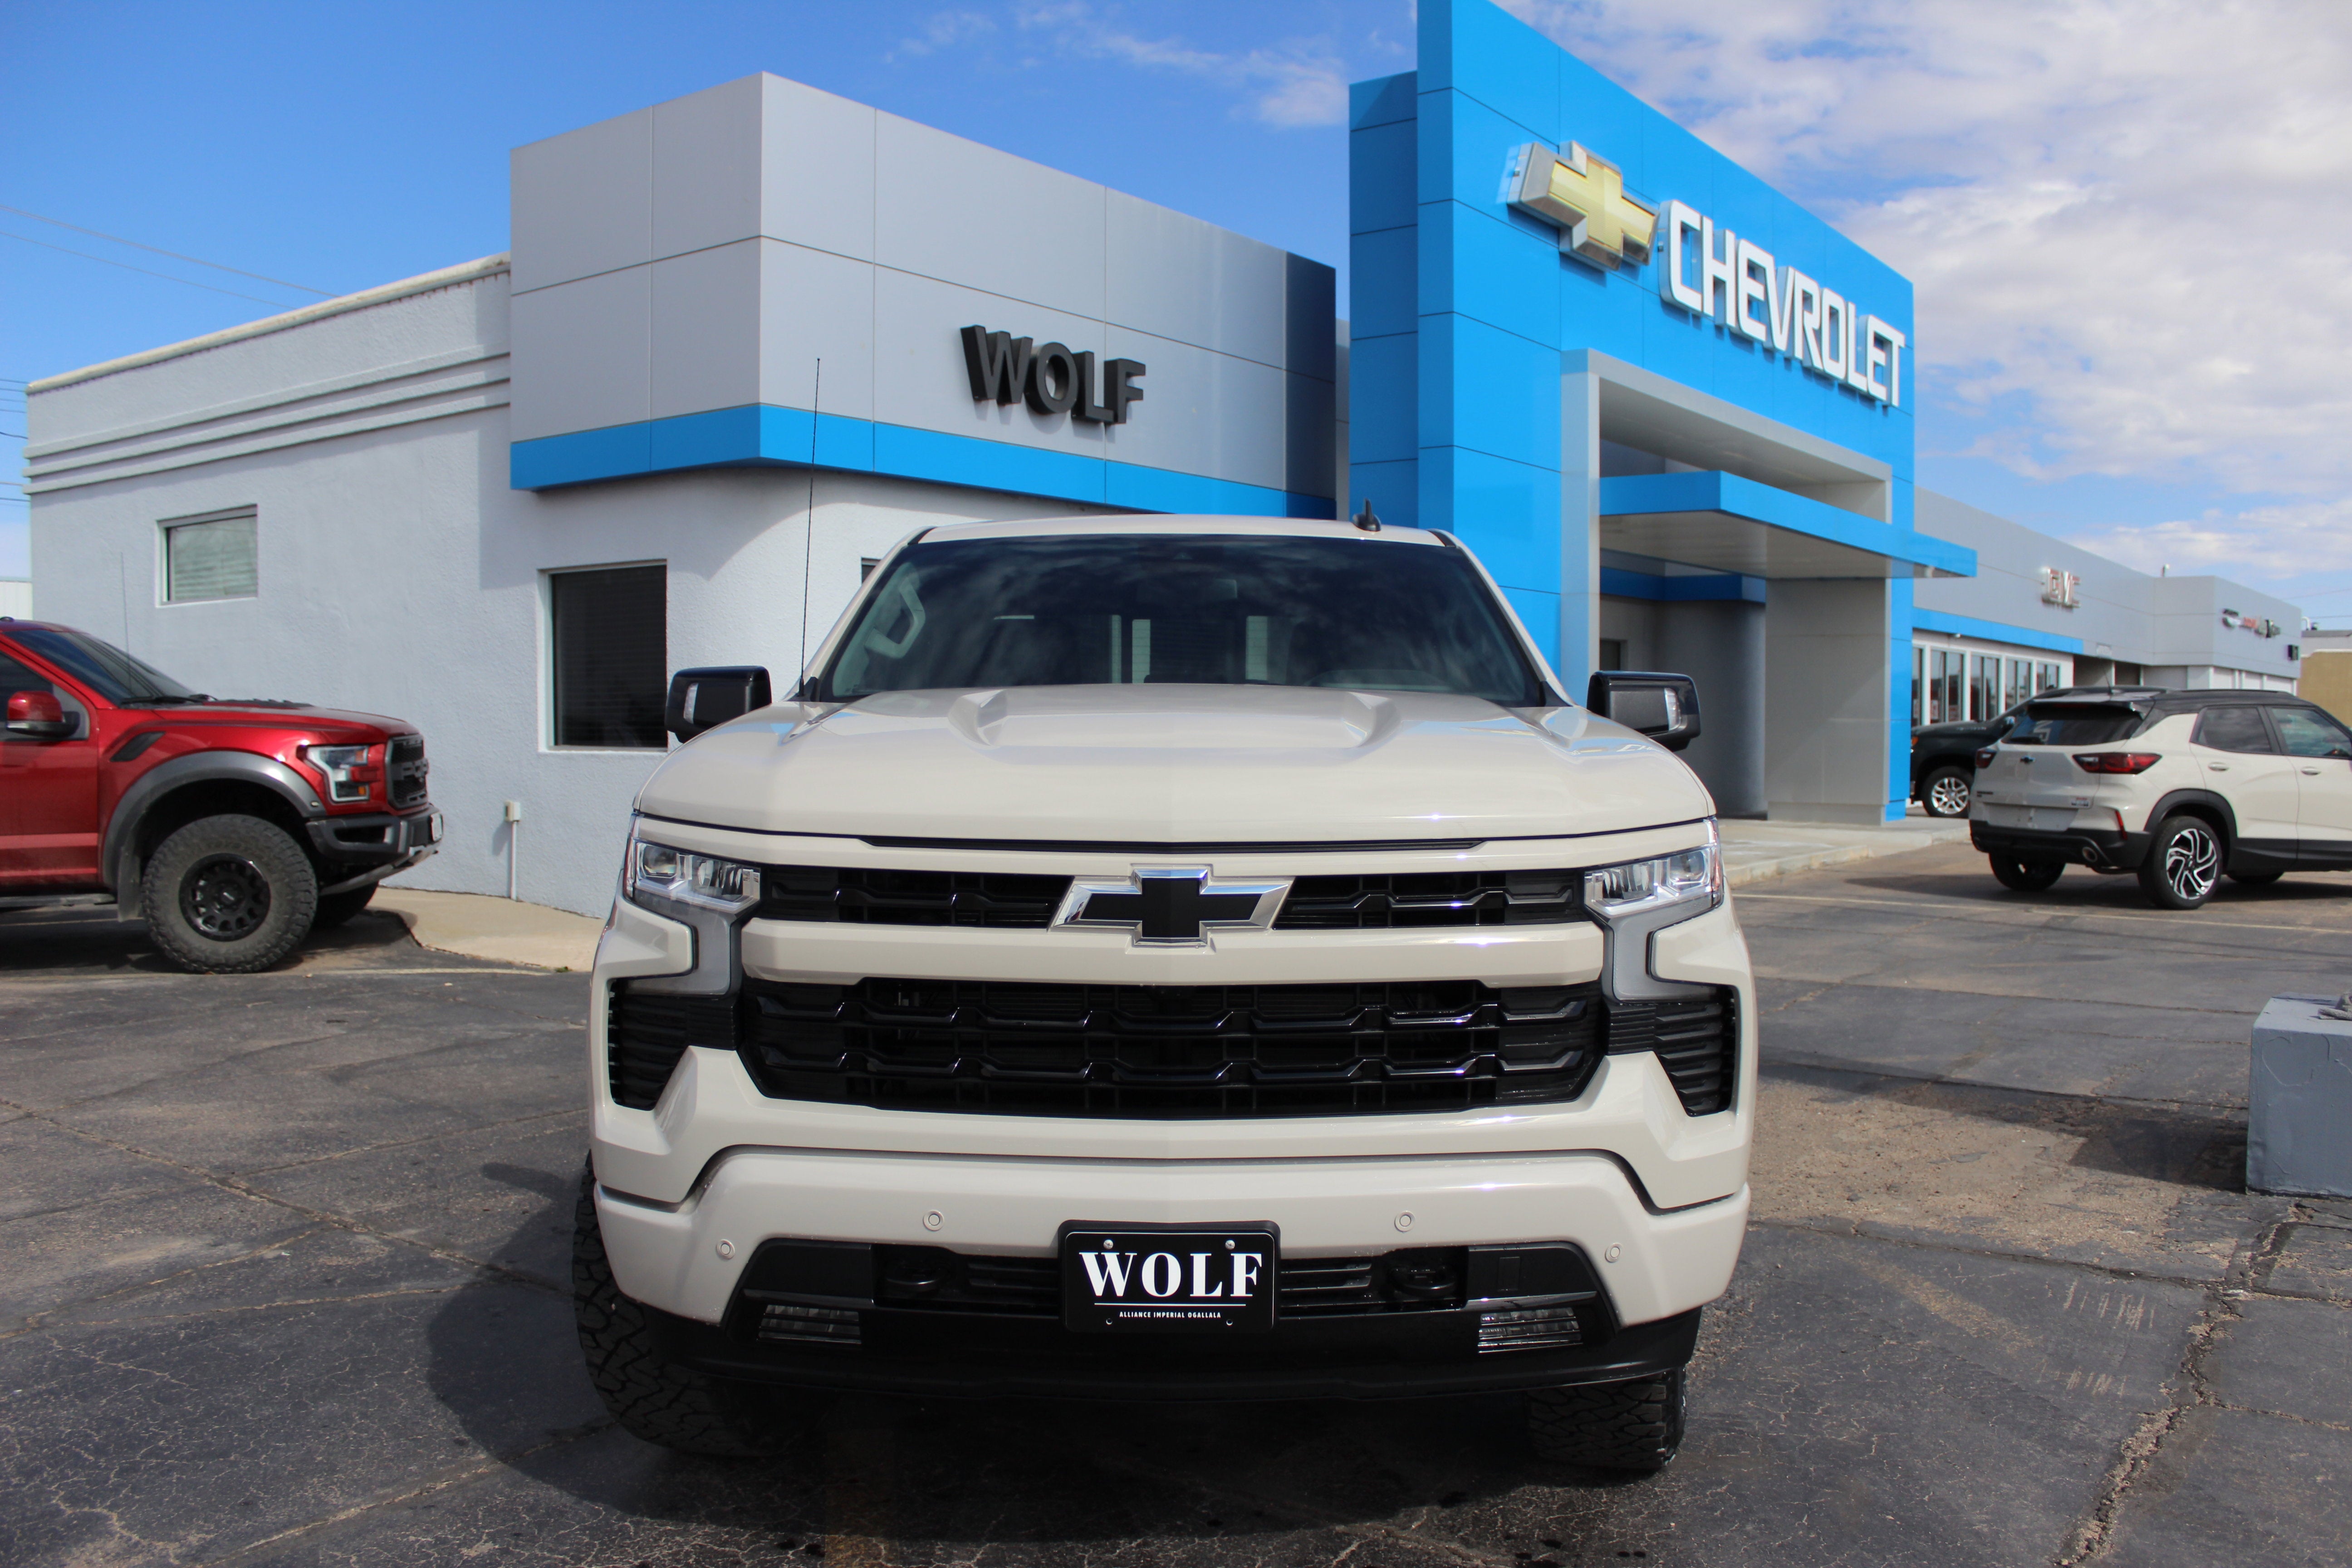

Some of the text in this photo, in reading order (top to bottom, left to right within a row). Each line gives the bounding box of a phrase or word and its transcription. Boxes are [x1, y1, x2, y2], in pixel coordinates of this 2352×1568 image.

[1659, 200, 1905, 407] CHEVROLET
[960, 324, 1146, 424] WOLF
[1078, 1252, 1262, 1297] WOLF
